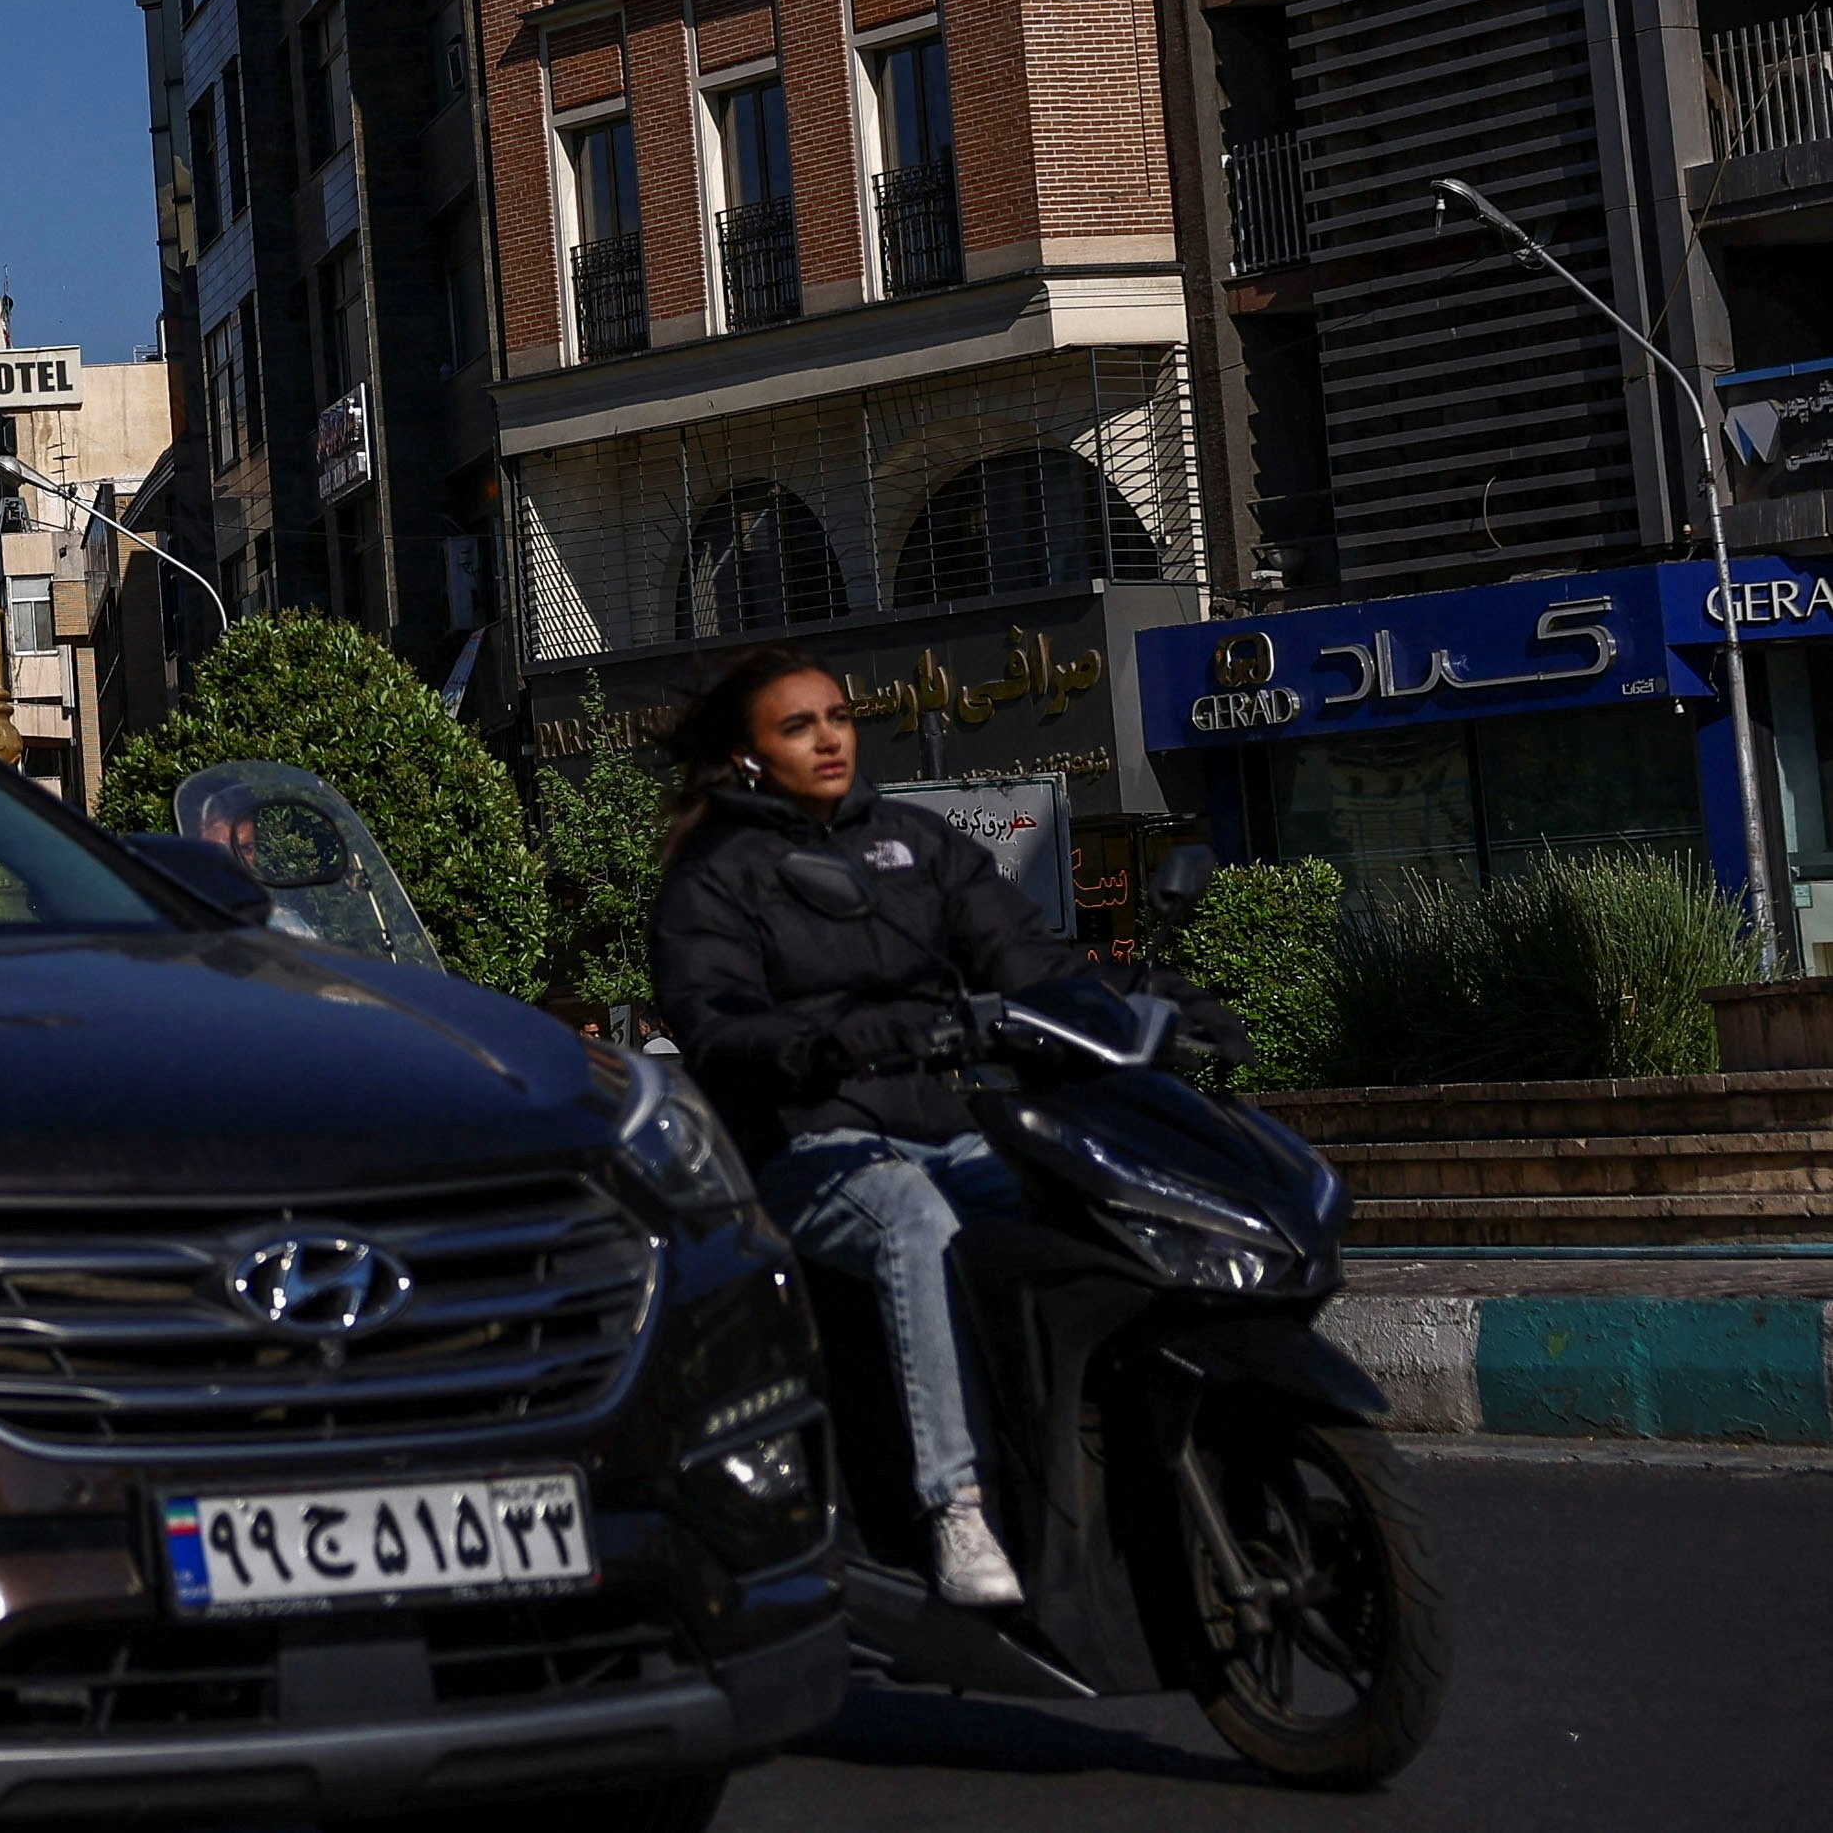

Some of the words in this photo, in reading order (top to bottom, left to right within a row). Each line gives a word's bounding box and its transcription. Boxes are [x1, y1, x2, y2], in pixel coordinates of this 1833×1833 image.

[958, 625, 1102, 724] صرافی
[1192, 687, 1300, 731] GERAD
[982, 814, 1008, 842] برق
[1006, 809, 1038, 840] خطر
[501, 1502, 575, 1569] ۳۳
